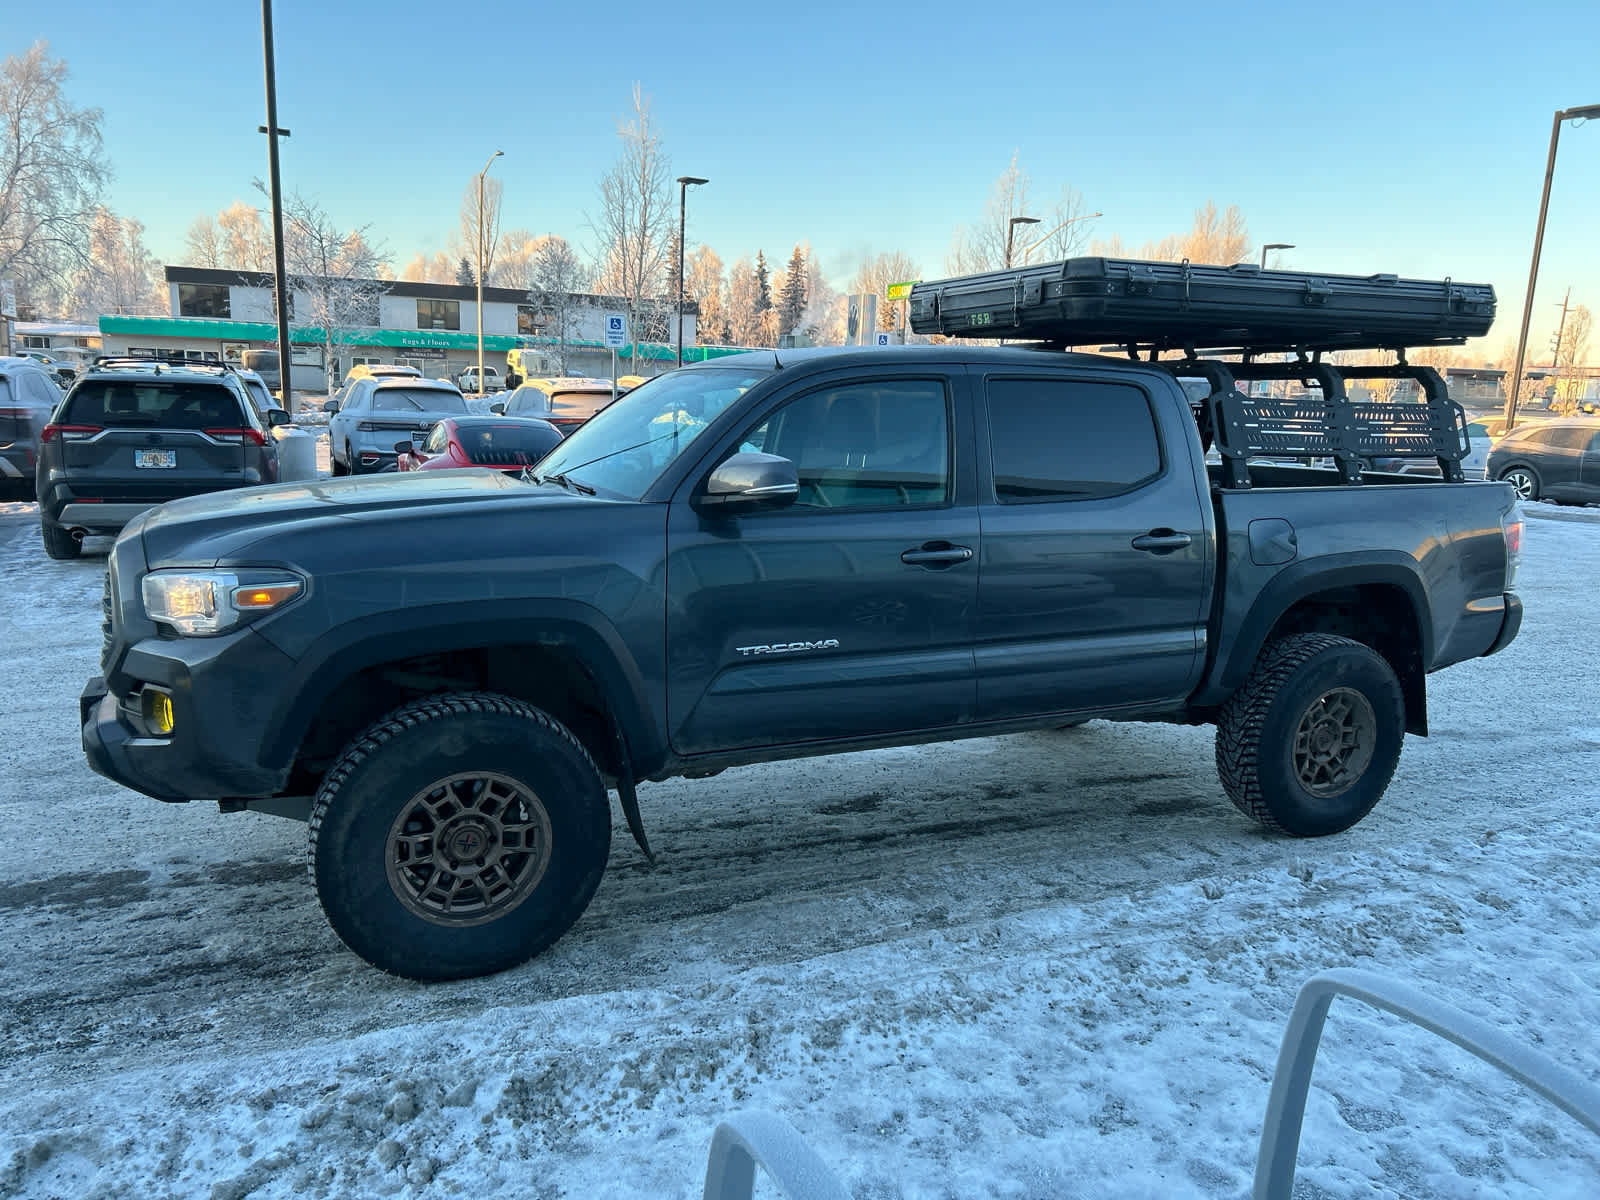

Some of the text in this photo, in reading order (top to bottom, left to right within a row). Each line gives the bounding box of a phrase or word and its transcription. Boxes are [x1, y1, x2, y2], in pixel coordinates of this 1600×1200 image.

[402, 338, 420, 346] Rugs
[427, 338, 450, 346] Floors
[735, 639, 840, 656] TACOMA
